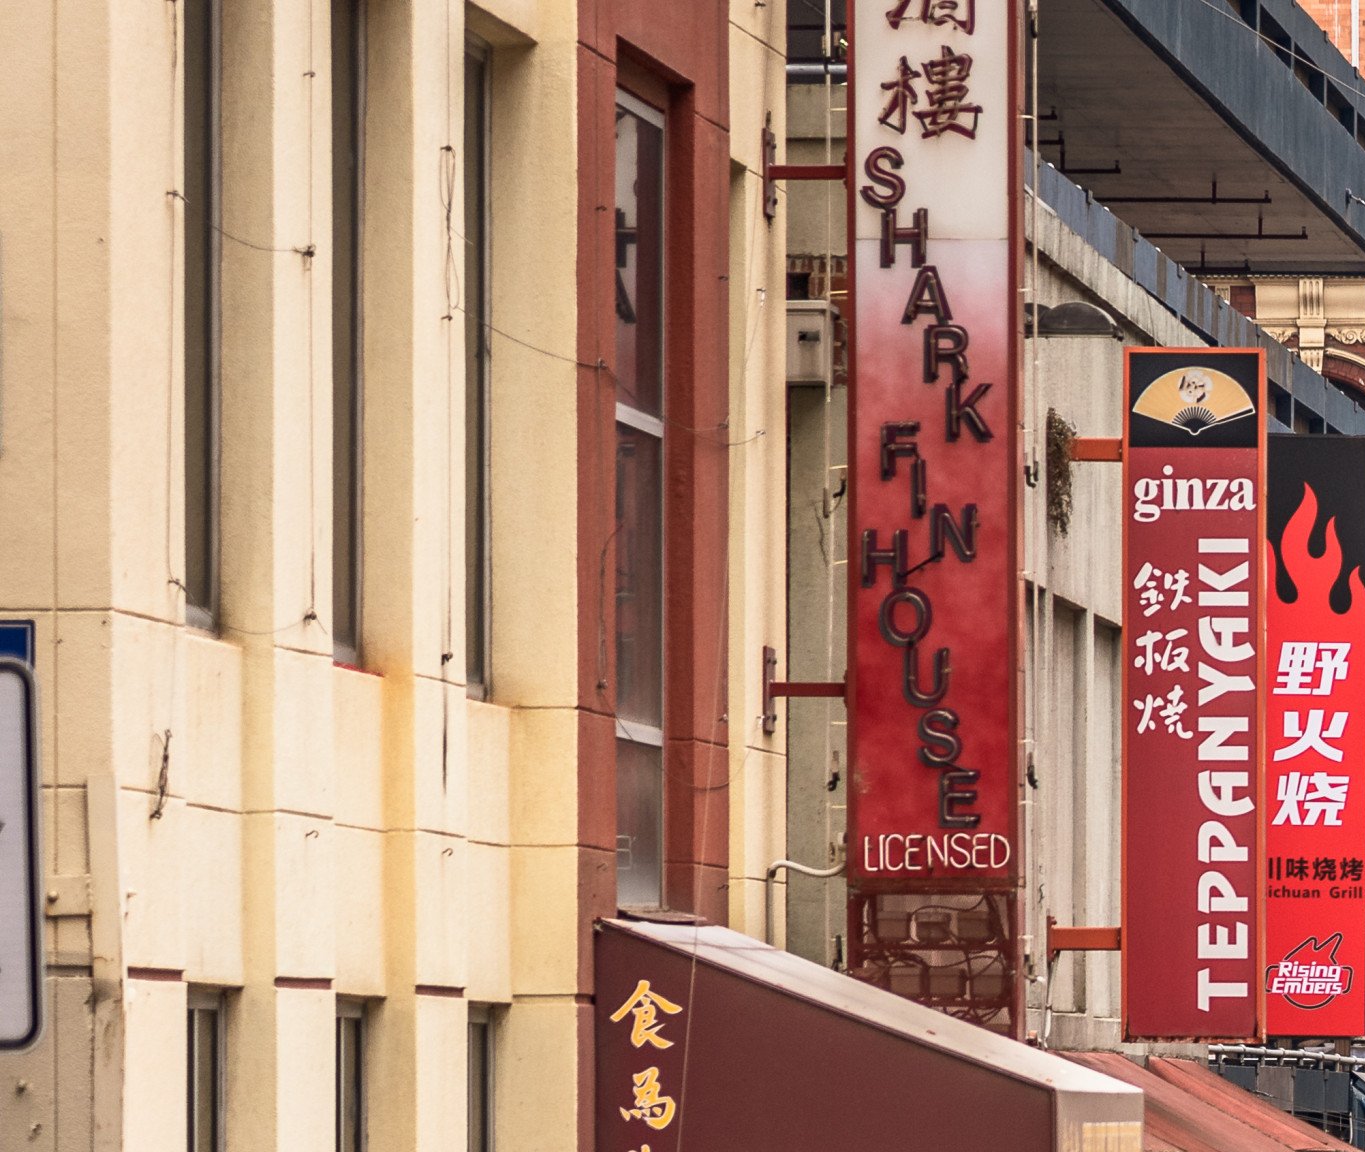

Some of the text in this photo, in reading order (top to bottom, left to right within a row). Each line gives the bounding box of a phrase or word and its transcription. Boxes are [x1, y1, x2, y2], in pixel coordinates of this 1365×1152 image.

[860, 146, 994, 443] SHARK
[881, 421, 977, 563] FIN
[1133, 464, 1257, 523] ginza
[861, 528, 980, 829] HOUSE
[1197, 537, 1256, 1013] TEPPANYAKI
[1271, 641, 1352, 826] 野火烧
[864, 833, 1011, 873] LICENSED
[1267, 885, 1363, 899] ichuan Grill
[1271, 976, 1343, 995] Embers
[1278, 960, 1342, 980] Rising
